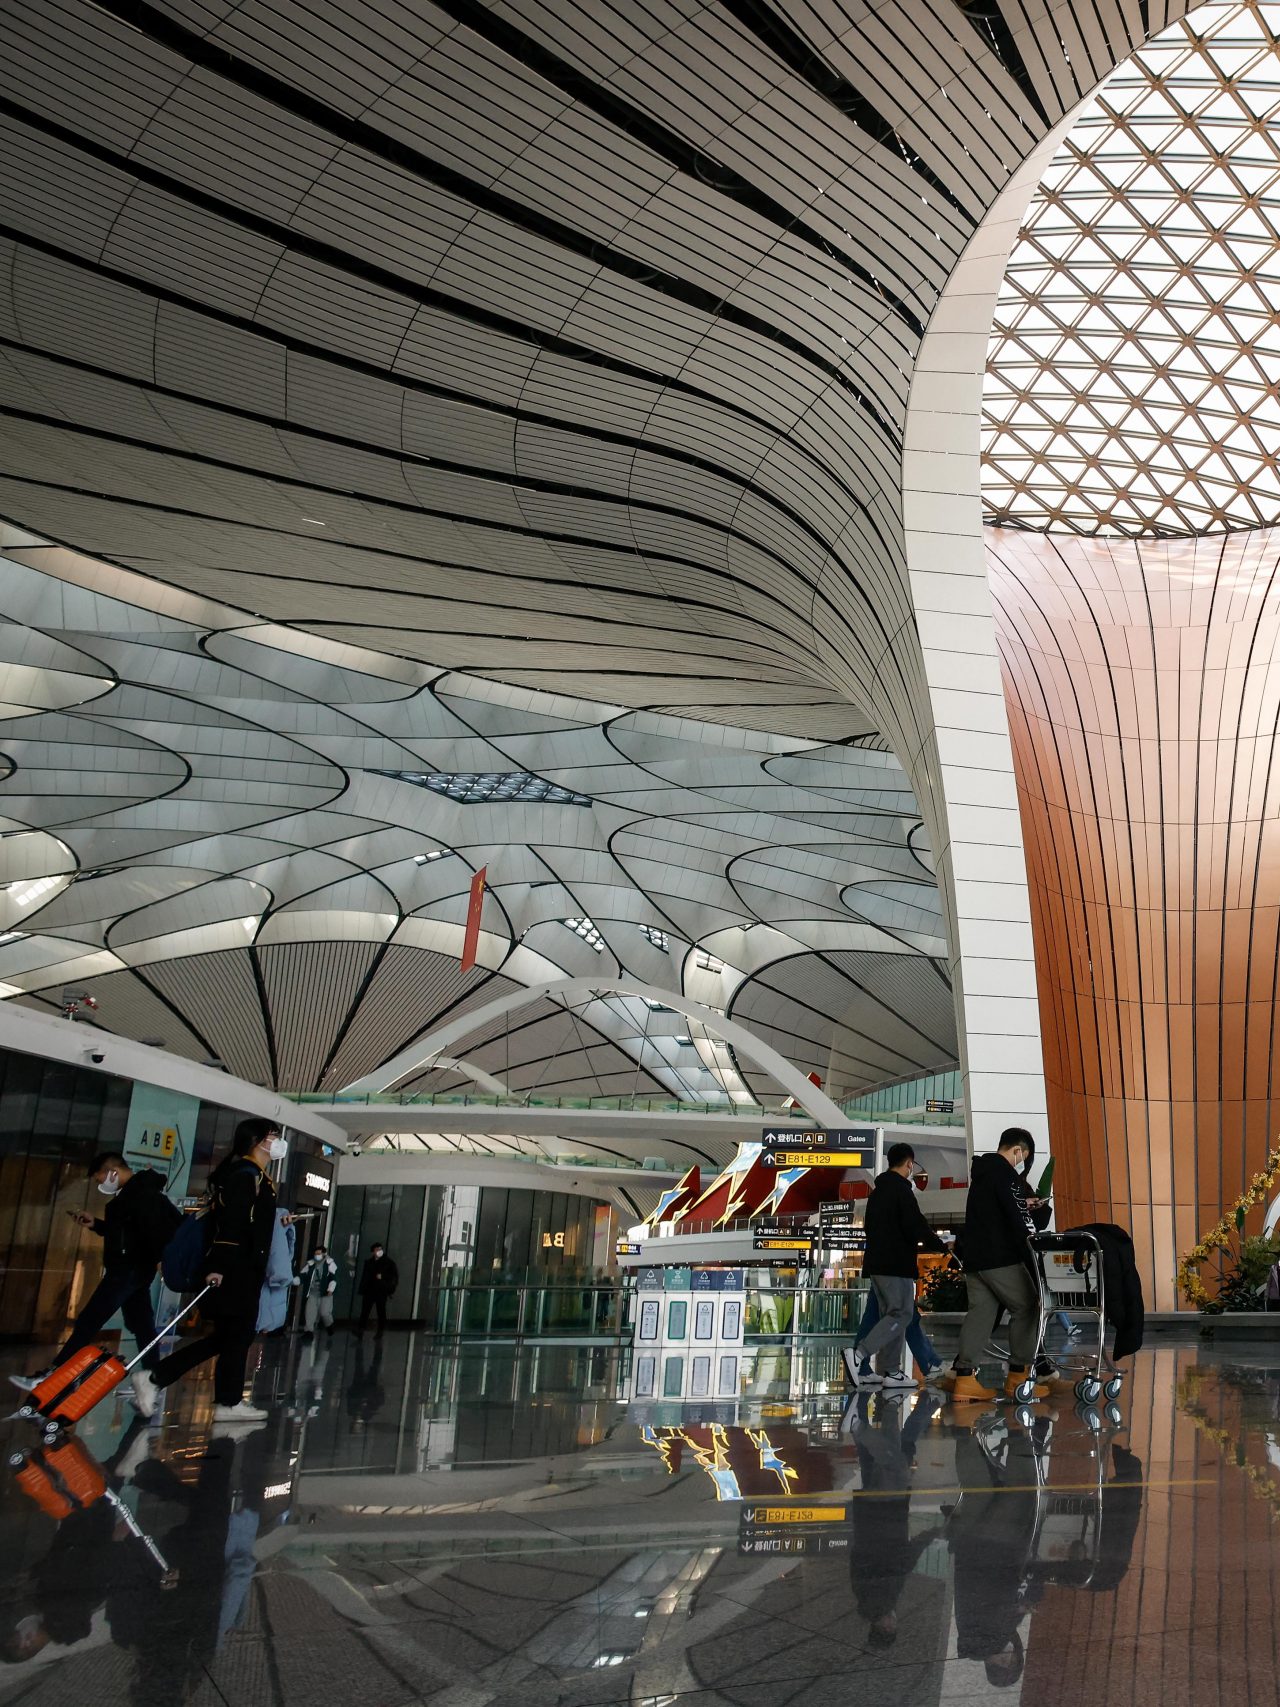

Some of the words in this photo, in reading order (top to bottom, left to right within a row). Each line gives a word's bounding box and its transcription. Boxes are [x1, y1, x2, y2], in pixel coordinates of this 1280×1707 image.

[140, 1129, 148, 1146] A
[153, 1132, 161, 1148] B
[777, 1133, 803, 1143] 登机口
[847, 1134, 866, 1143] Gates
[787, 1155, 831, 1164] E81-E129
